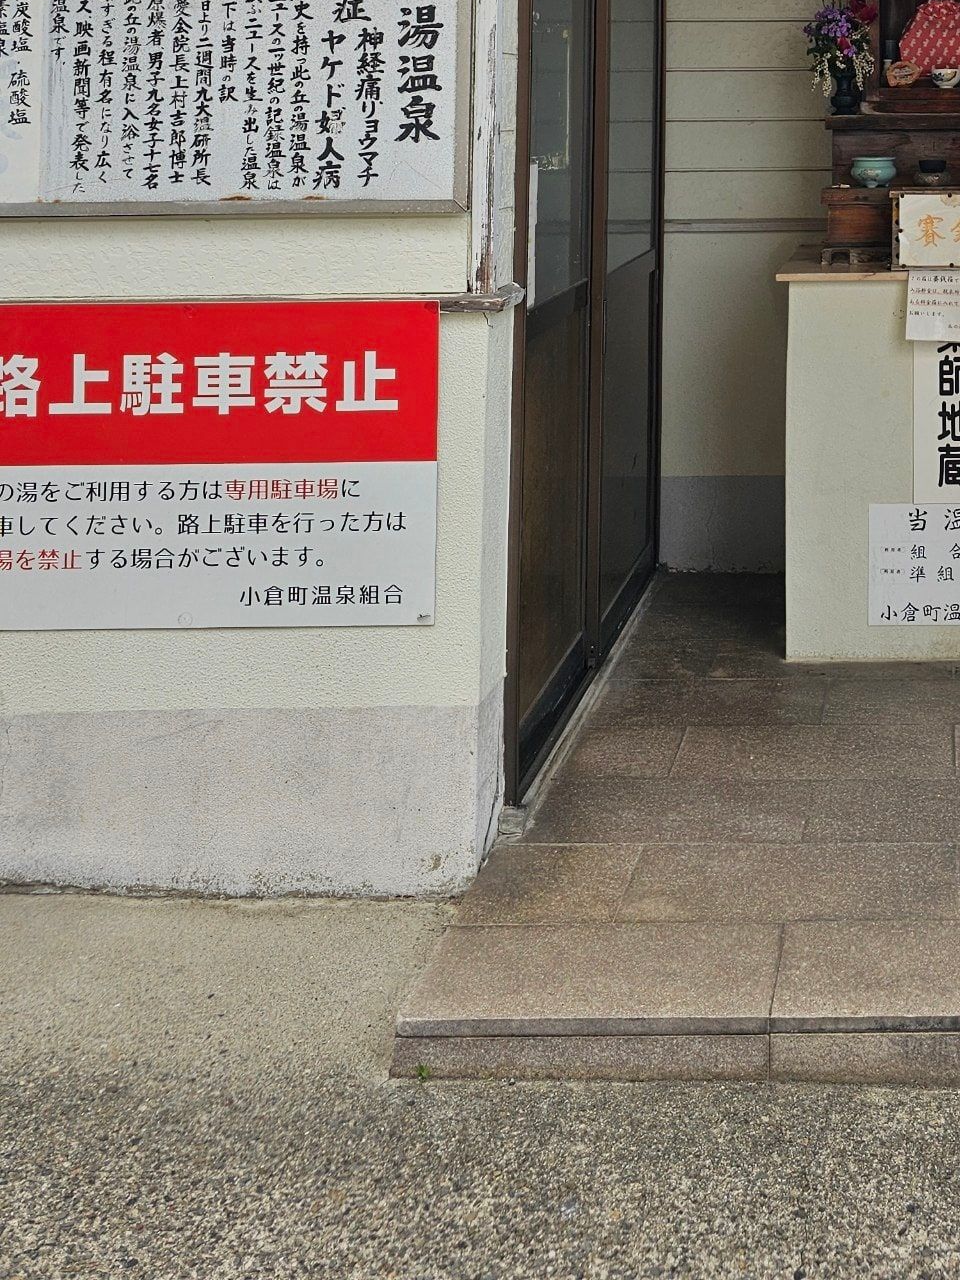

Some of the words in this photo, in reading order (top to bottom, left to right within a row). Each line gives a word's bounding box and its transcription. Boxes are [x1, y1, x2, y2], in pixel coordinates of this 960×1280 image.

[239, 584, 404, 607] 小倉町温泉組合
